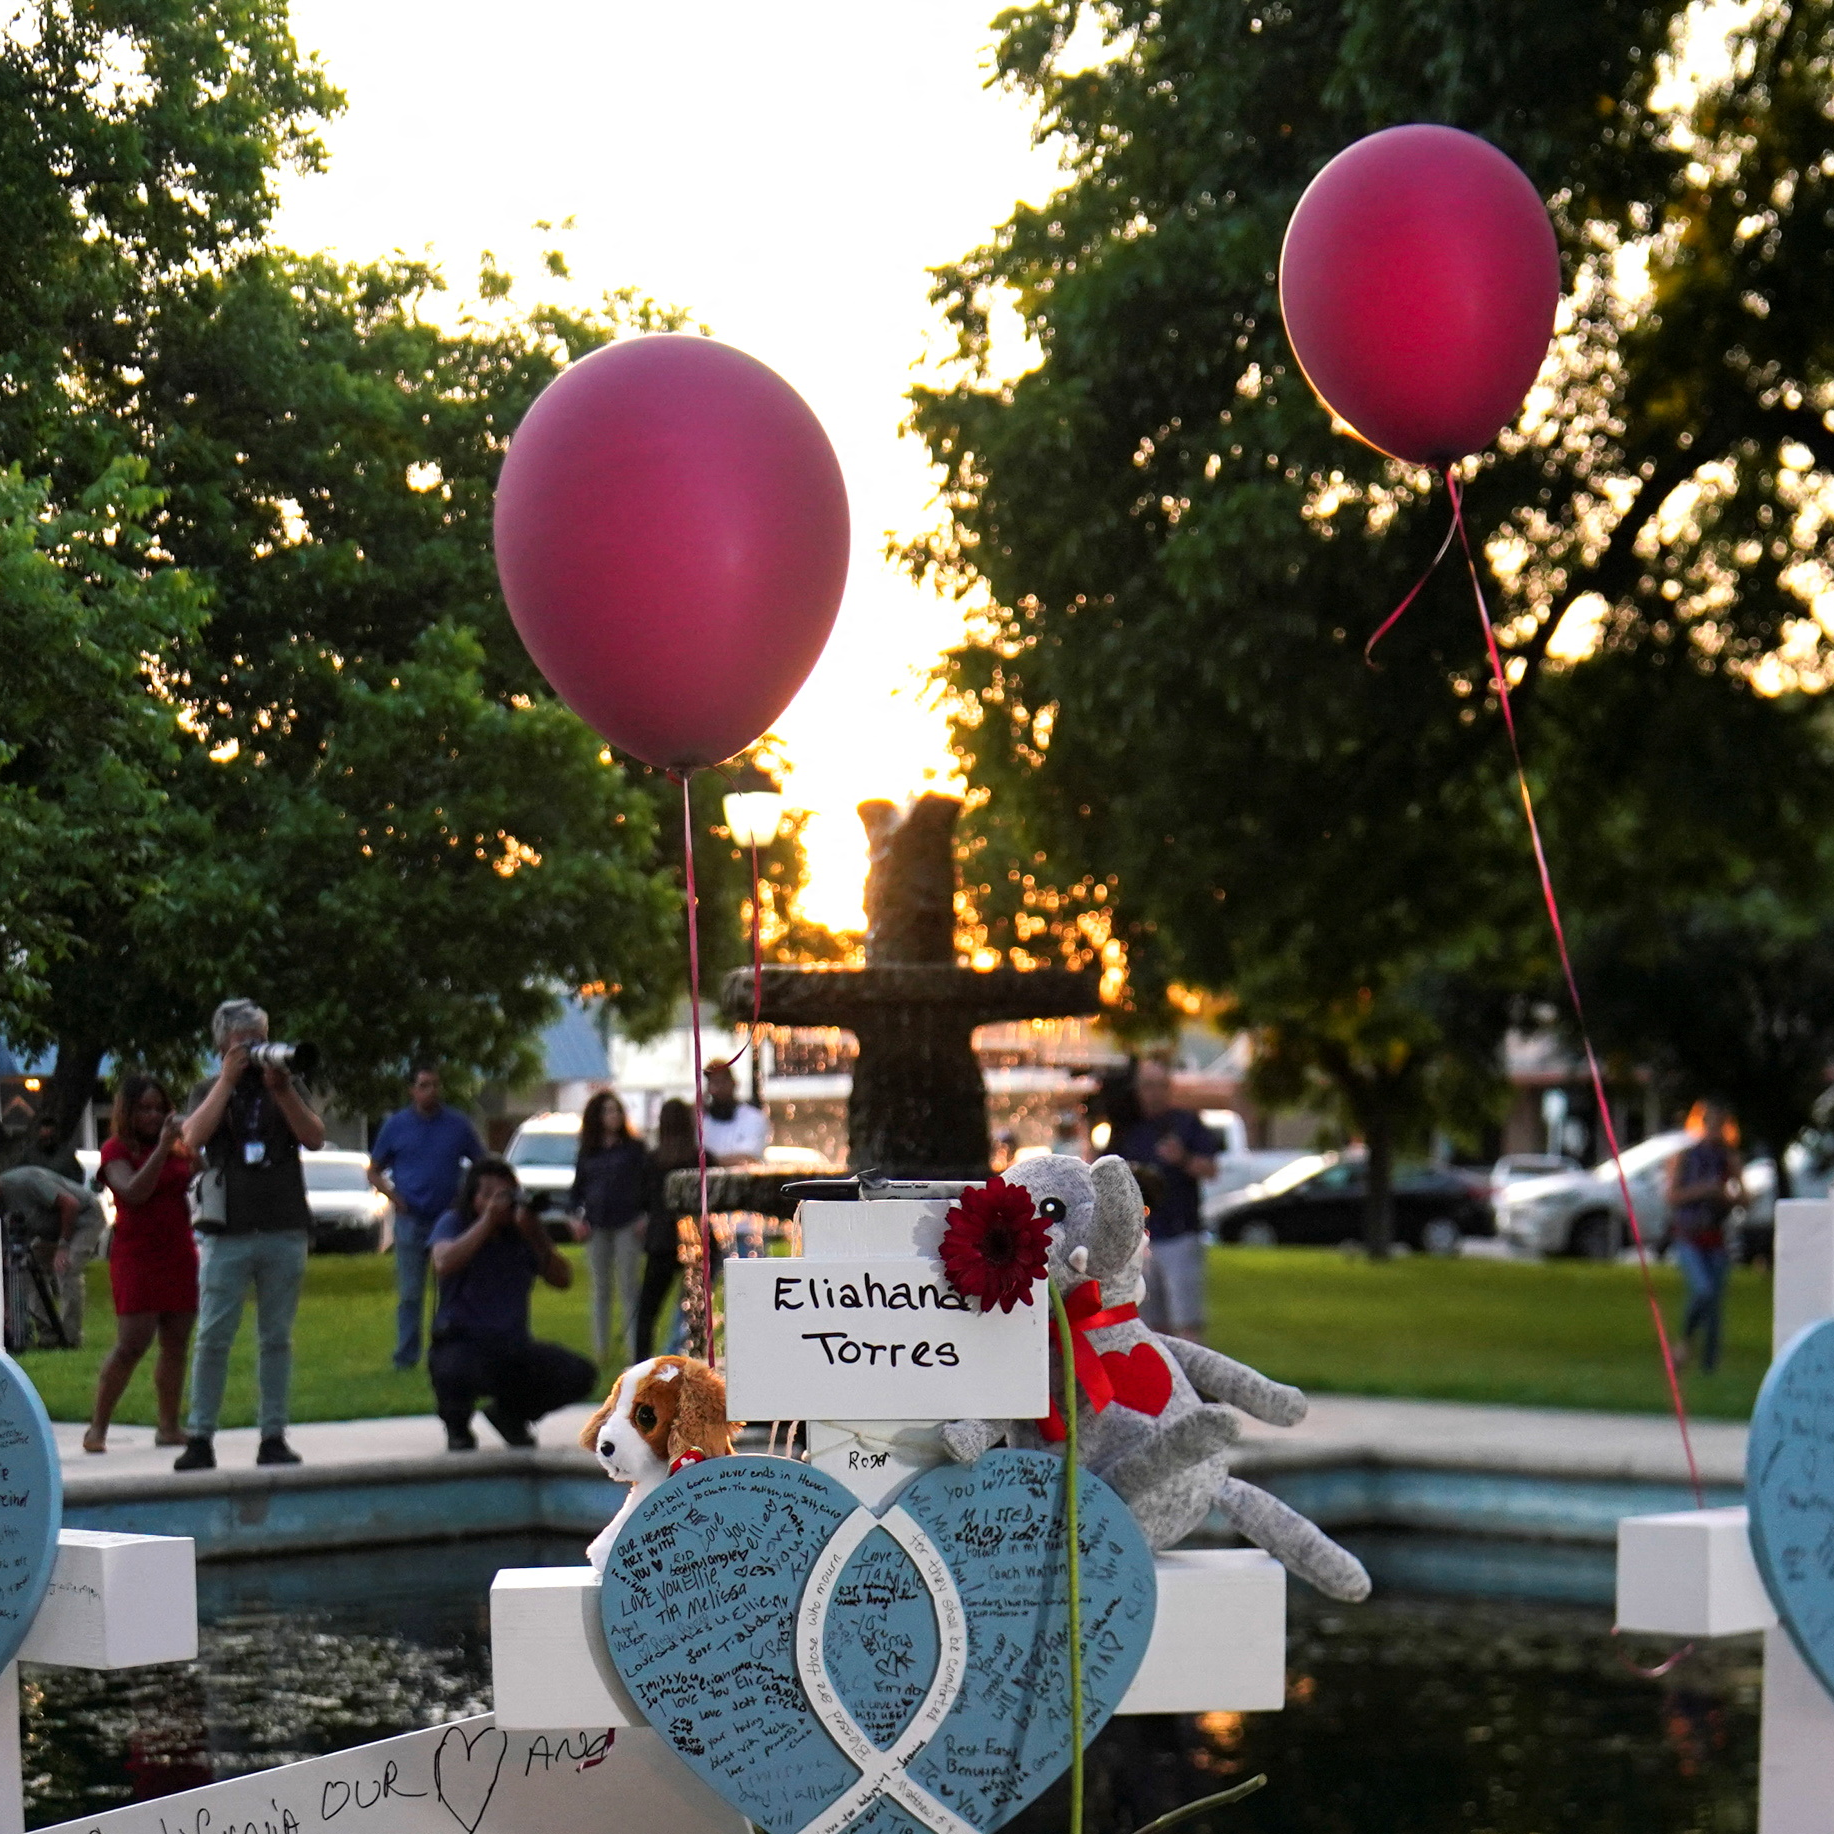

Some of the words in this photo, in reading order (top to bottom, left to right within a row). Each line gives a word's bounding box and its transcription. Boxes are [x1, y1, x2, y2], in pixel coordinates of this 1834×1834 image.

[774, 1272, 970, 1311] Eliahana
[802, 1332, 960, 1367] Torres
[631, 1564, 651, 1582] YOU
[816, 1553, 843, 1597] mourn
[908, 1532, 931, 1555] for
[928, 1560, 948, 1594] they
[943, 1599, 959, 1631] shall
[688, 1583, 748, 1619] Melissa
[808, 1603, 822, 1626] who
[807, 1637, 822, 1677] those
[825, 1710, 872, 1762] Blessed
[321, 1759, 429, 1820] OUR
